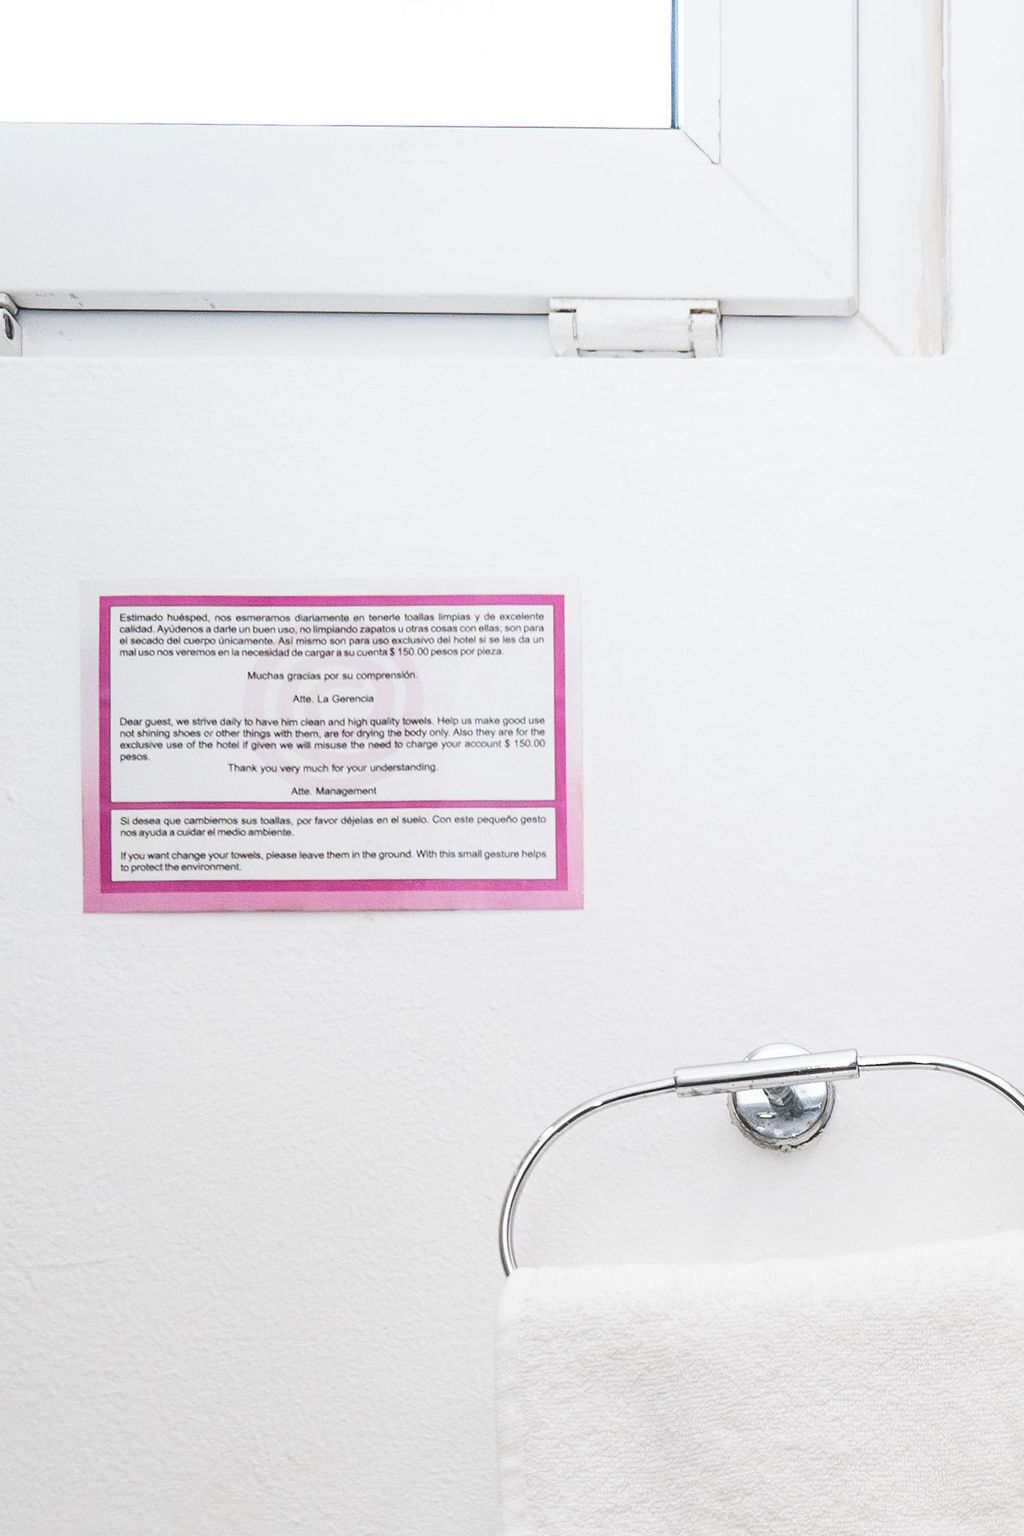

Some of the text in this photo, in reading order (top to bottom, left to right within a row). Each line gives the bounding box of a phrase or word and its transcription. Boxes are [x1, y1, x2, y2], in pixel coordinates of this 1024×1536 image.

[120, 613, 163, 622] Estimado
[294, 613, 349, 621] diariamente
[369, 613, 400, 621] tenerle
[404, 613, 434, 621] toallas
[438, 613, 470, 623] limpias
[500, 612, 544, 621] excelente
[213, 625, 236, 633] darle
[253, 625, 275, 633] buen
[313, 624, 358, 635] limpiando
[360, 625, 396, 635] zapatos
[524, 626, 544, 634] para
[130, 636, 164, 645] secado
[166, 636, 180, 645] del
[183, 638, 216, 646] cuerpo
[278, 636, 293, 644] Así
[296, 636, 326, 644] mismo
[349, 638, 370, 646] para
[391, 636, 434, 644] exclusivo
[453, 636, 476, 644] hotel
[120, 648, 136, 656] mal
[242, 648, 289, 656] necesidad
[305, 650, 334, 658] cargar
[398, 648, 428, 656] 150.00
[431, 649, 458, 658] pesos
[460, 649, 474, 658] por
[248, 671, 284, 680] Muchas
[287, 671, 321, 681] gracias
[324, 673, 338, 681] por
[332, 695, 374, 703] Gerencia
[120, 718, 142, 726] Dear
[192, 718, 217, 726] strive
[220, 717, 242, 728] daily
[256, 717, 278, 726] have
[281, 717, 298, 726] him
[300, 717, 325, 726] clean
[328, 717, 345, 725] and
[348, 717, 367, 727] high
[370, 717, 400, 727] quality
[437, 717, 458, 727] Help
[475, 716, 500, 725] make
[503, 716, 525, 726] good
[137, 730, 170, 740] shining
[173, 729, 201, 738] shoes
[216, 729, 240, 738] other
[243, 729, 270, 739] things
[274, 729, 292, 737] with
[342, 729, 354, 737] for
[356, 728, 384, 739] drying
[388, 728, 402, 737] the
[404, 728, 426, 738] body
[453, 728, 473, 736] Also
[476, 728, 495, 738] they
[516, 728, 528, 736] for
[531, 728, 545, 736] the
[120, 741, 163, 749] exclusive
[198, 741, 213, 749] the
[216, 741, 239, 749] hotel
[251, 740, 276, 751] given
[296, 740, 311, 749] will
[314, 740, 347, 749] misuse
[350, 740, 364, 749] the
[368, 740, 391, 749] need
[406, 740, 438, 750] charge
[441, 742, 461, 750] your
[515, 740, 545, 748] 150.00
[229, 764, 257, 772] Thank
[260, 766, 277, 774] you
[280, 766, 300, 774] very
[303, 764, 328, 772] much
[331, 764, 344, 772] for
[346, 766, 367, 774] your
[316, 787, 376, 797] Management
[132, 816, 160, 825] desea
[163, 818, 181, 826] que
[297, 818, 312, 826] por
[315, 816, 338, 824] favor
[432, 816, 451, 824] Con
[477, 815, 518, 826] pequeño
[520, 816, 546, 826] gesto
[139, 828, 167, 838] ayuda
[176, 828, 205, 836] cuidar
[217, 828, 246, 836] medio
[128, 854, 145, 862] you
[171, 851, 206, 862] change
[208, 853, 228, 861] your
[266, 851, 297, 861] please
[299, 851, 324, 859] leave
[327, 851, 350, 859] them
[362, 851, 376, 859] the
[416, 850, 437, 859] With
[439, 850, 455, 859] this
[458, 850, 482, 859] small
[484, 851, 519, 860] gesture
[522, 850, 546, 860] helps
[131, 864, 163, 873] protect
[165, 863, 179, 872] the
